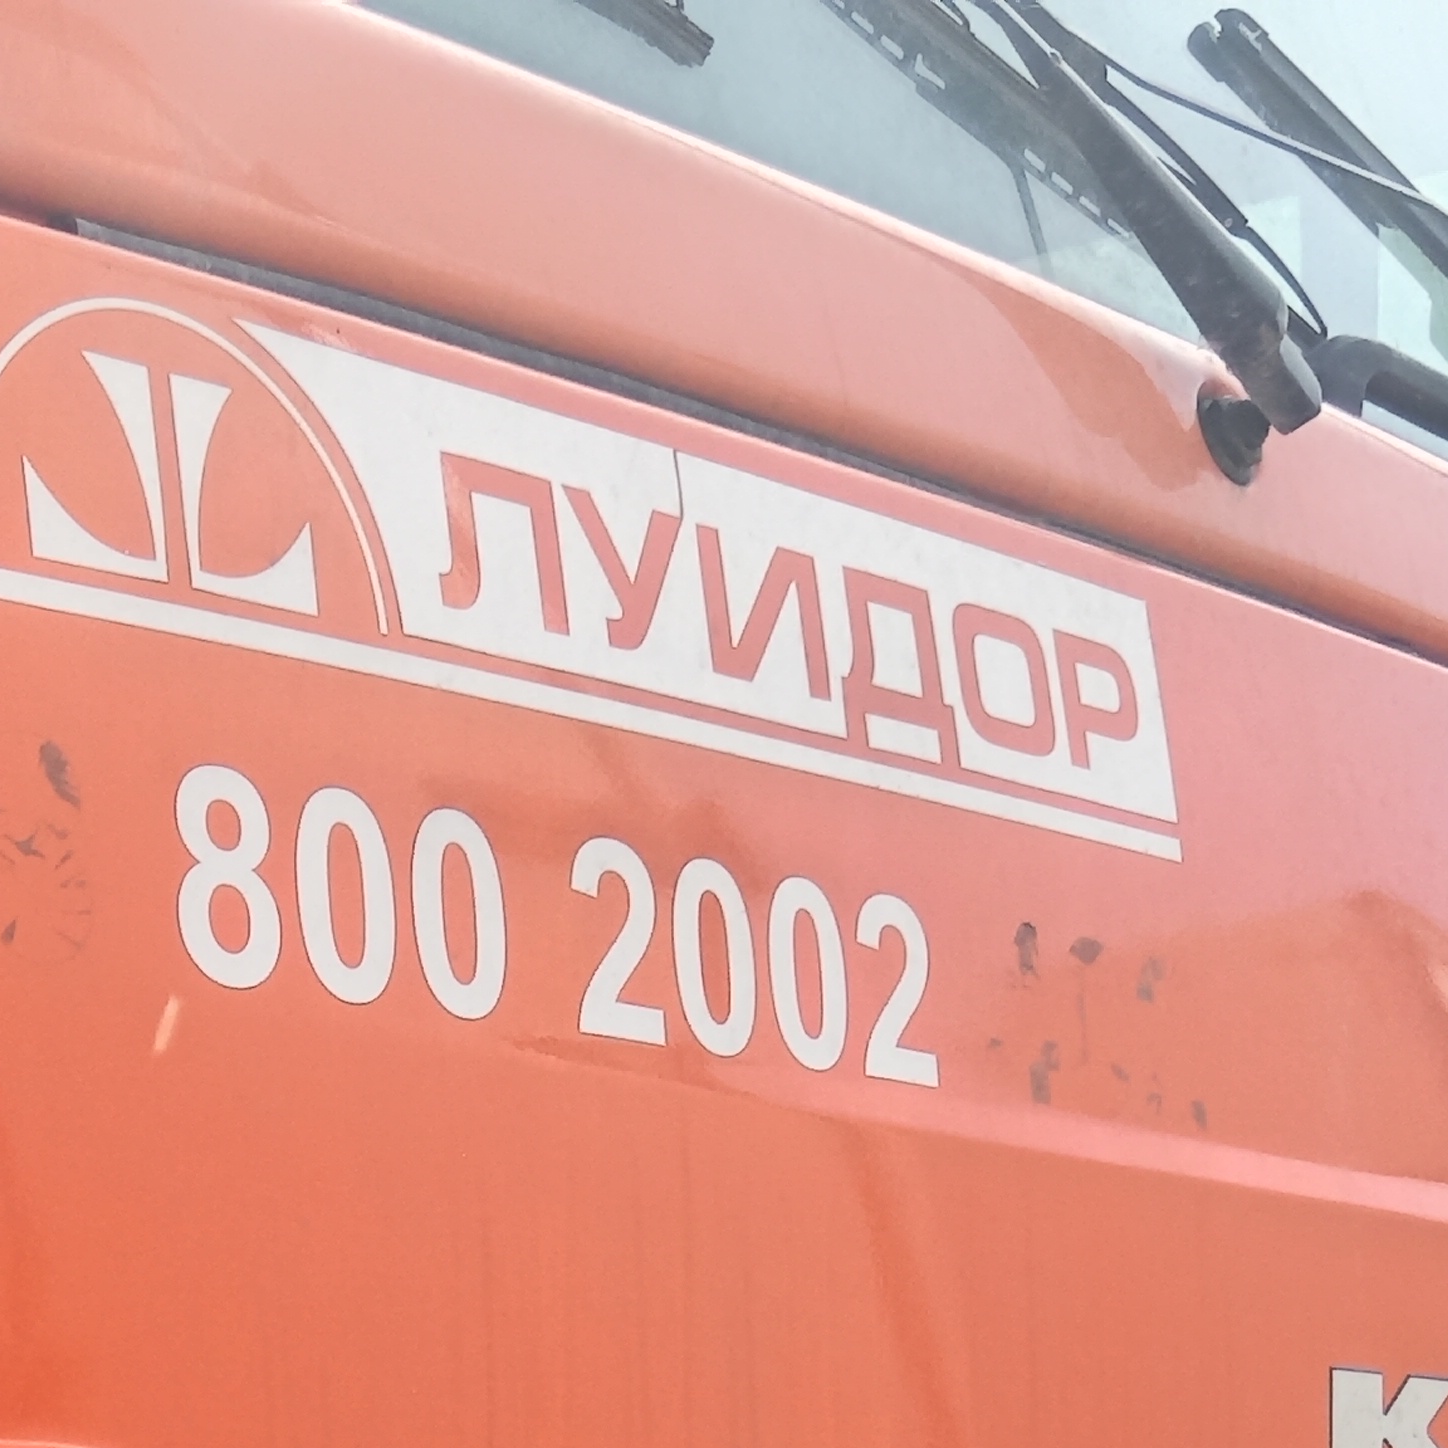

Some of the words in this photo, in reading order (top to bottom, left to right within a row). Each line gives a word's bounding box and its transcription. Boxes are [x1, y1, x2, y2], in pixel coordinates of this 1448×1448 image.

[438, 449, 1140, 771] ЛУИДОР
[175, 763, 507, 1022] 800
[569, 836, 941, 1090] 2002
